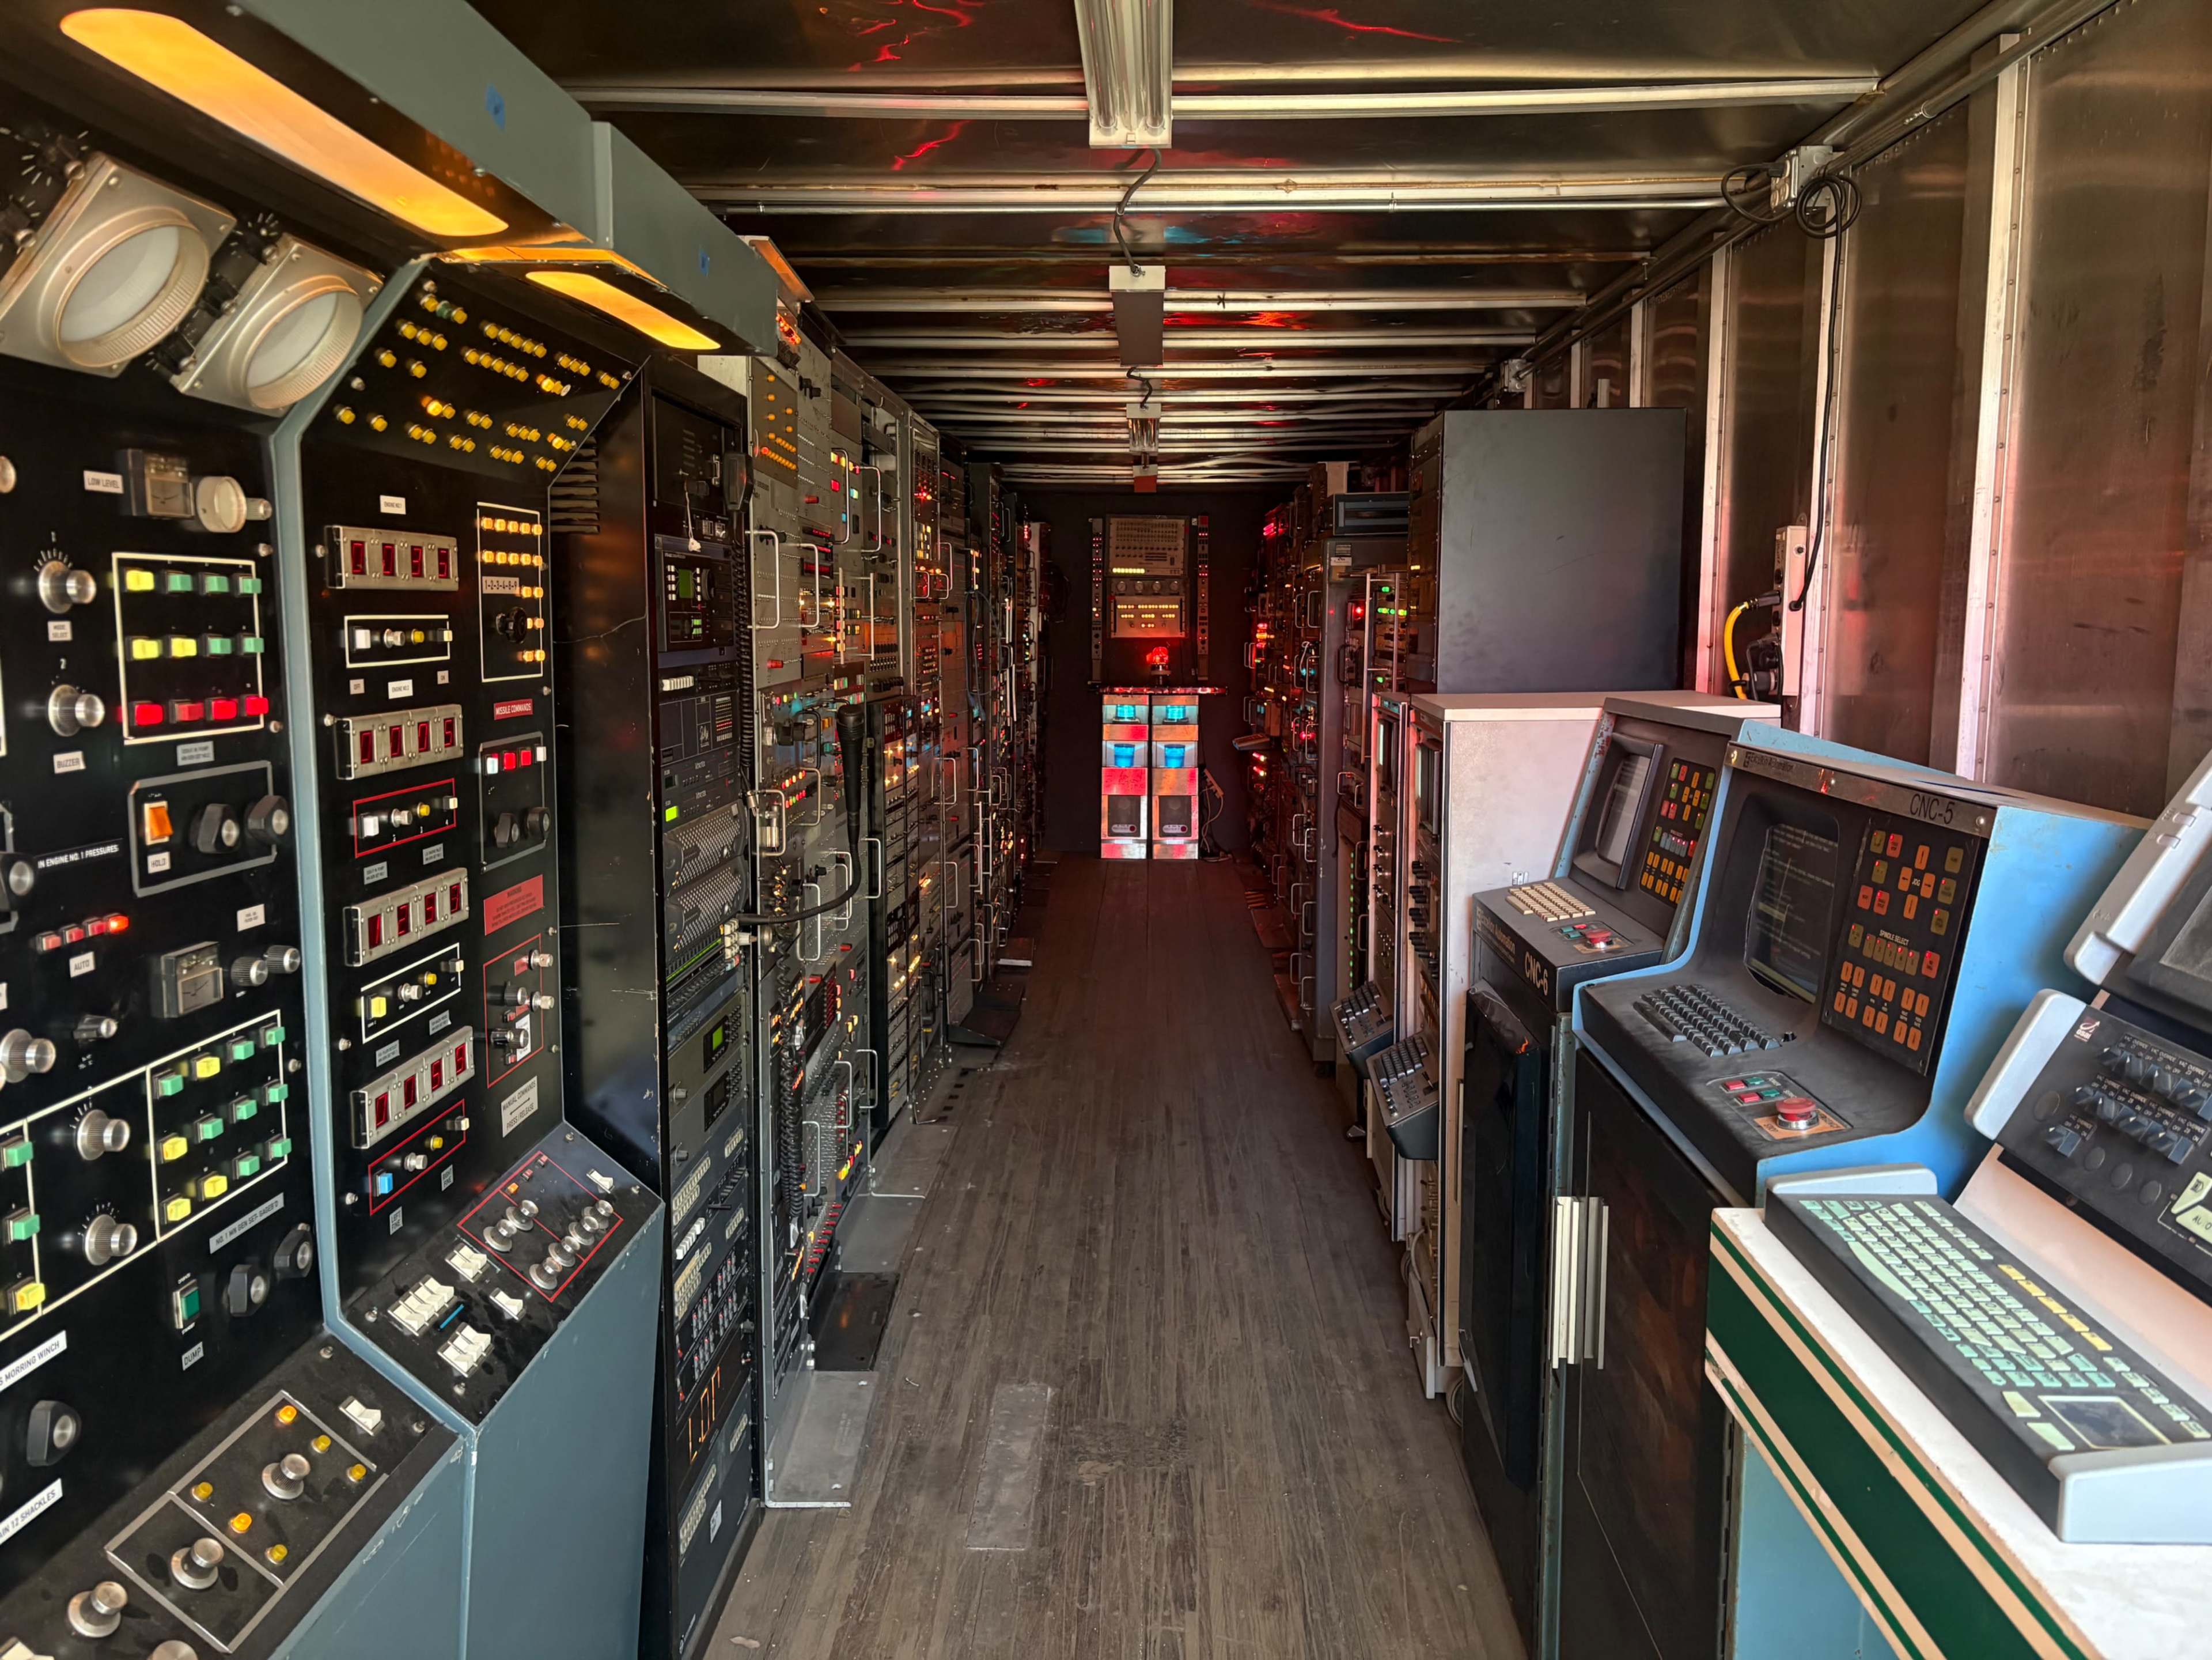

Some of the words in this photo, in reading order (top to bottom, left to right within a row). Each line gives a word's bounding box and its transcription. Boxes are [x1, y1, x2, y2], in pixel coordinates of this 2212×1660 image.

[101, 479, 120, 489] LEVEL
[495, 705, 510, 716] MISSILE
[511, 702, 532, 713] COMMANDS
[57, 758, 81, 768] BUZZER
[1910, 793, 1955, 825] CNC-5
[46, 855, 69, 867] ENGINE
[85, 844, 119, 858] PRESSURES
[151, 858, 166, 868] HOLD
[1879, 929, 1894, 940] SPINDLE
[1895, 935, 1910, 946] SELECT
[74, 960, 89, 971] AUTO
[1525, 952, 1548, 996] CNC-6
[507, 1116, 517, 1130] PRESS
[520, 1102, 534, 1118] RELEASE
[2192, 1215, 2212, 1230] AUO
[5, 1356, 36, 1382] MORRING
[37, 1340, 60, 1360] WINCH
[184, 1347, 202, 1366] DUMP
[21, 1489, 56, 1522] SHACKLES
